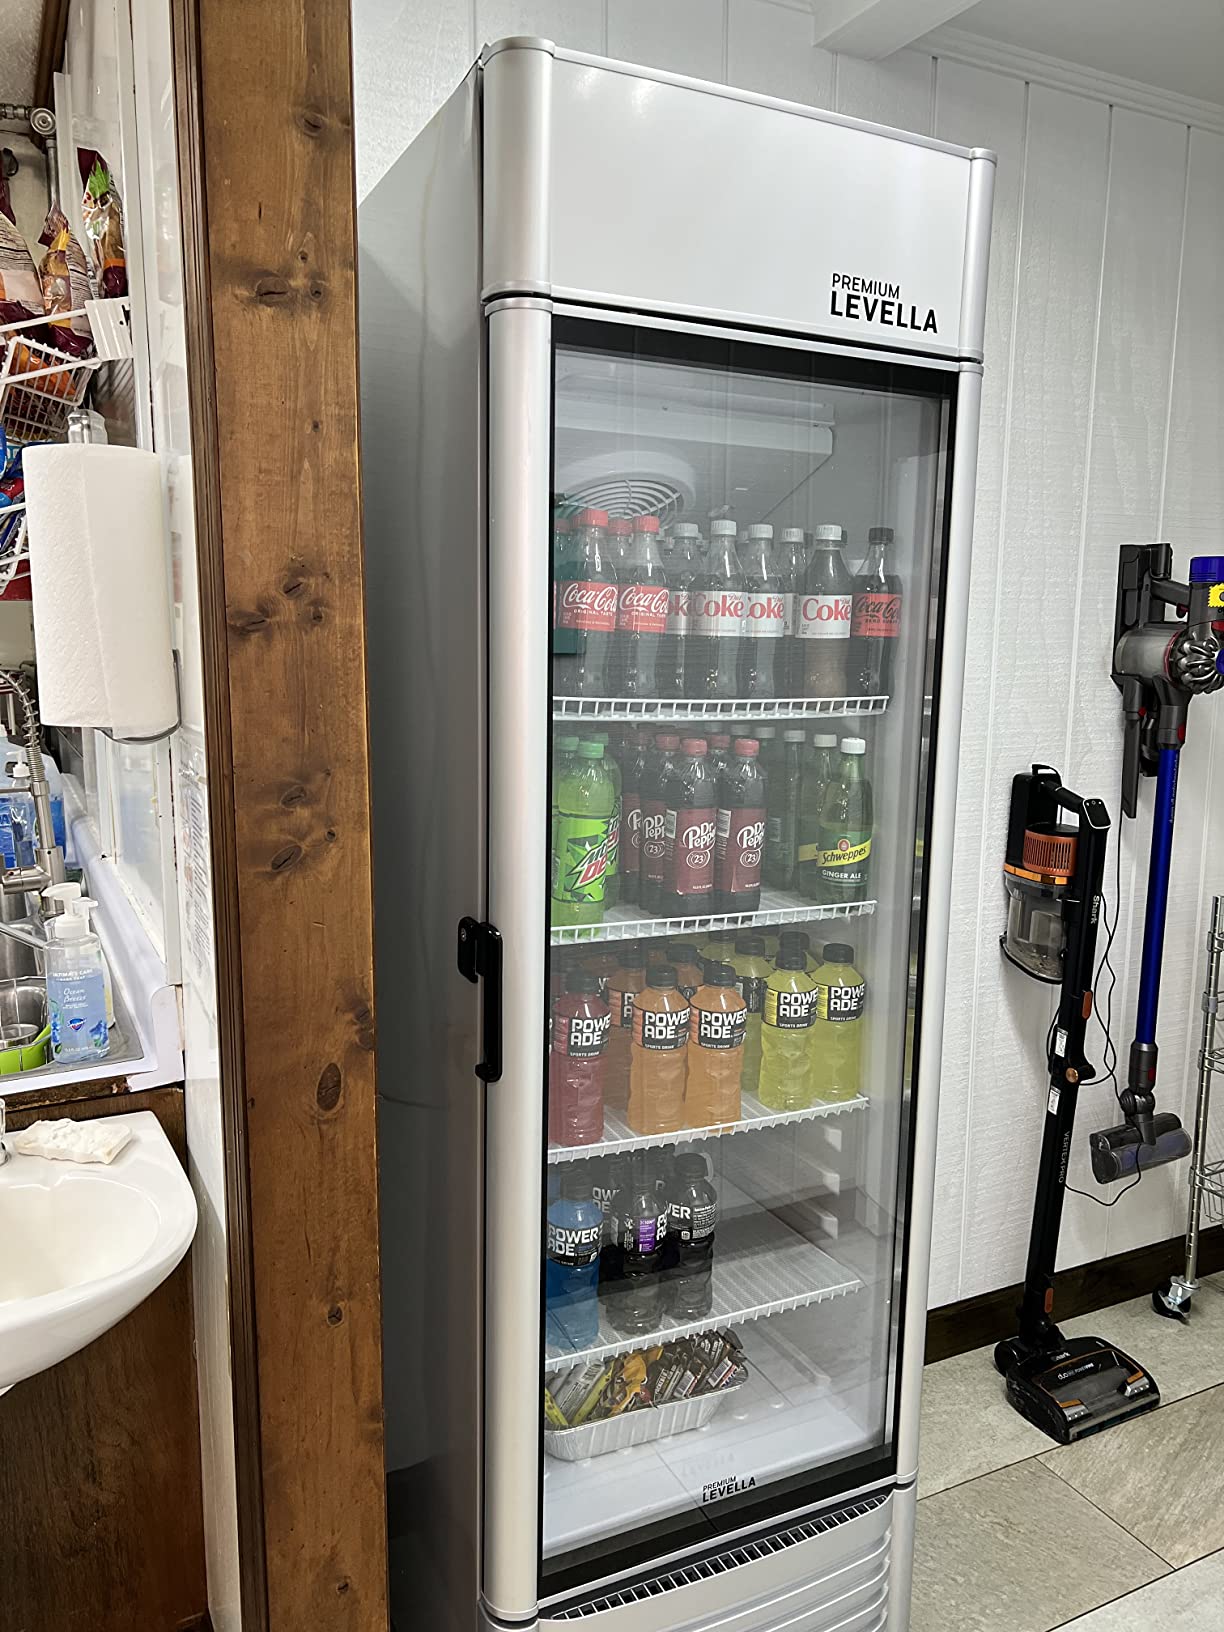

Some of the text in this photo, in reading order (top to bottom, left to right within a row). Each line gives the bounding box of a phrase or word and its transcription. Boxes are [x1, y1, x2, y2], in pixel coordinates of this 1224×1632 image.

[831, 272, 900, 300] PREMIUM
[830, 290, 938, 334] LEVELLA
[694, 855, 704, 864] 23
[747, 854, 757, 863] 23
[822, 846, 867, 865] Schweppes
[822, 869, 849, 879] GINGER
[1090, 894, 1100, 925] Shark
[780, 986, 819, 1006] POWE
[1058, 1130, 1071, 1183] VERTEX PRO
[548, 1223, 599, 1244] POWER
[702, 1475, 737, 1492] PREMIUM
[702, 1476, 756, 1503] LEVELLA
